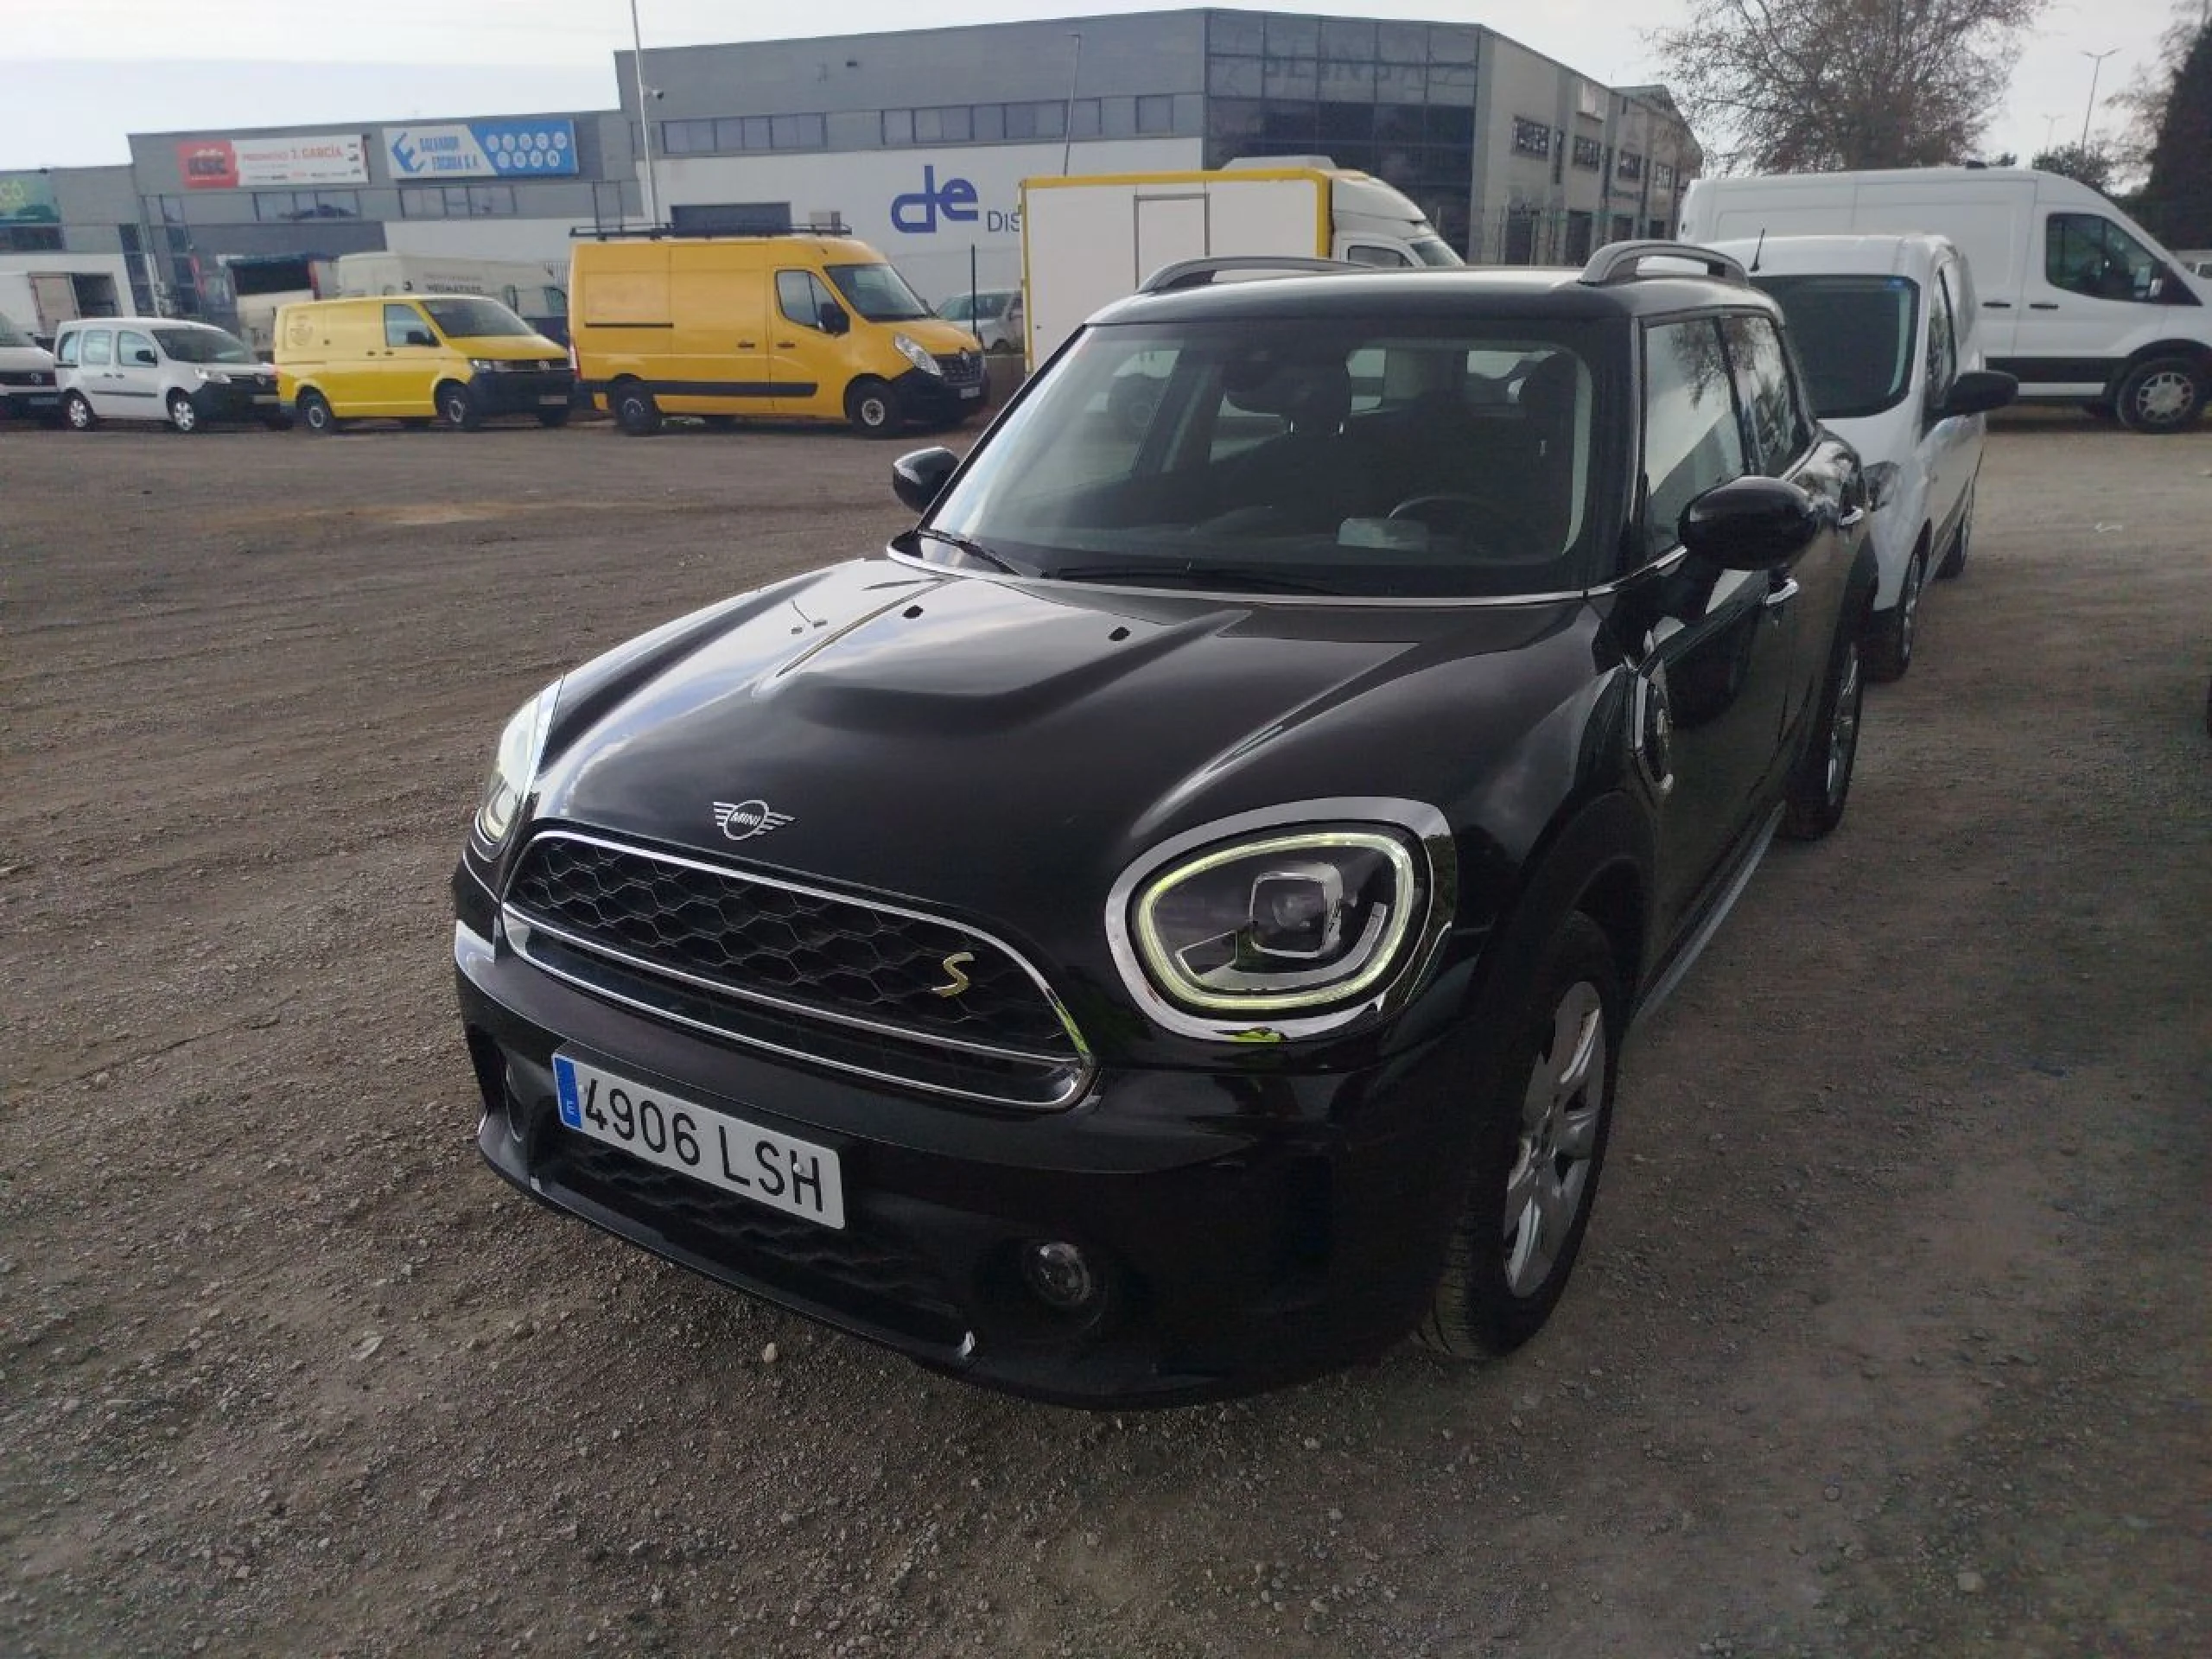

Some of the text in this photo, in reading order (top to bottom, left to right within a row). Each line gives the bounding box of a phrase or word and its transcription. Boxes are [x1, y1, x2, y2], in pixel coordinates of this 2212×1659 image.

[891, 164, 978, 233] de
[729, 811, 761, 827] MINI
[931, 951, 975, 997] S
[566, 1100, 575, 1116] E
[585, 1077, 823, 1212] 4906 LSH
